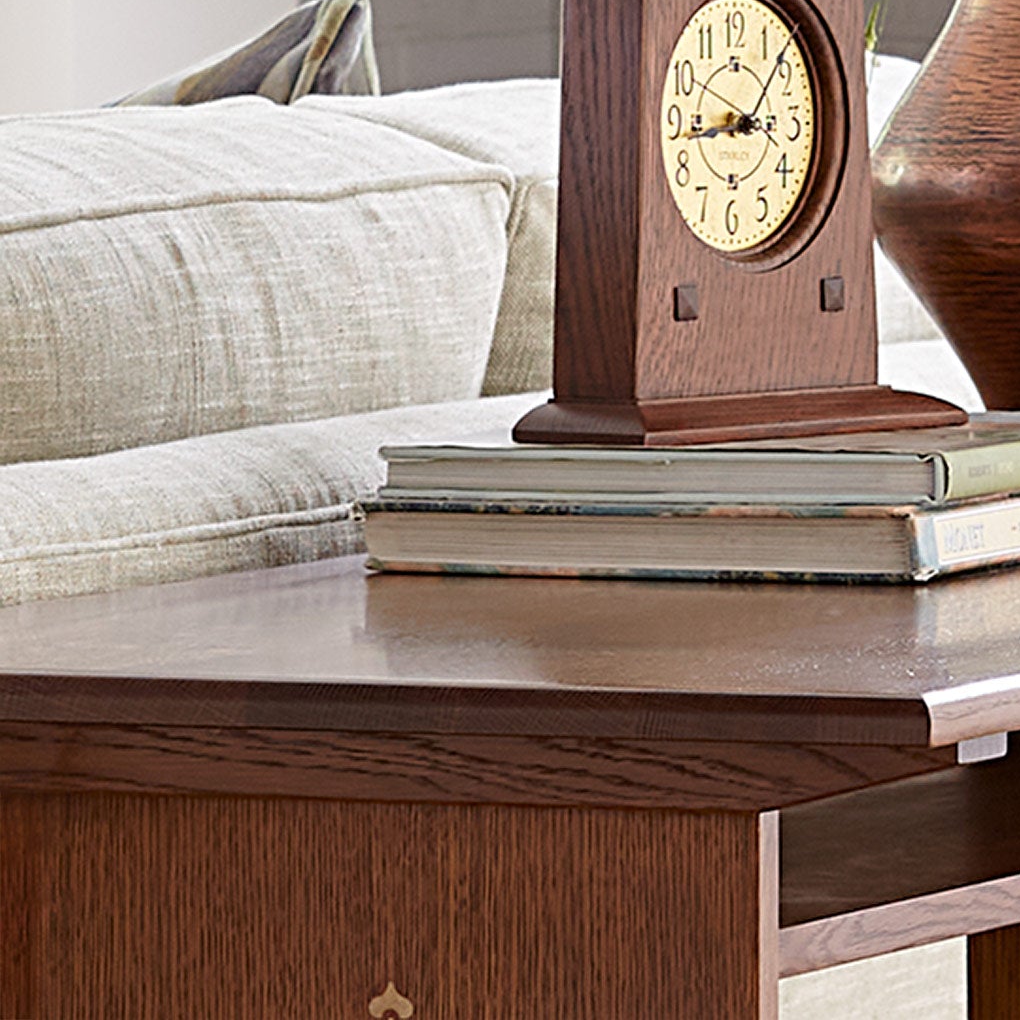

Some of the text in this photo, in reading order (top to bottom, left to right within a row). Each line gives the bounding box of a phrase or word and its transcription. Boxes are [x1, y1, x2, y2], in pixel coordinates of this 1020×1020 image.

[699, 24, 712, 59] 11
[726, 11, 745, 48] 12
[762, 25, 768, 60] 1
[674, 60, 694, 96] 10
[778, 60, 792, 96] 2
[668, 104, 682, 140] 9
[787, 105, 801, 141] 3
[675, 150, 690, 187] 8
[775, 152, 794, 188] 4
[695, 186, 708, 222] 7
[725, 200, 739, 235] 6
[756, 186, 769, 222] 5
